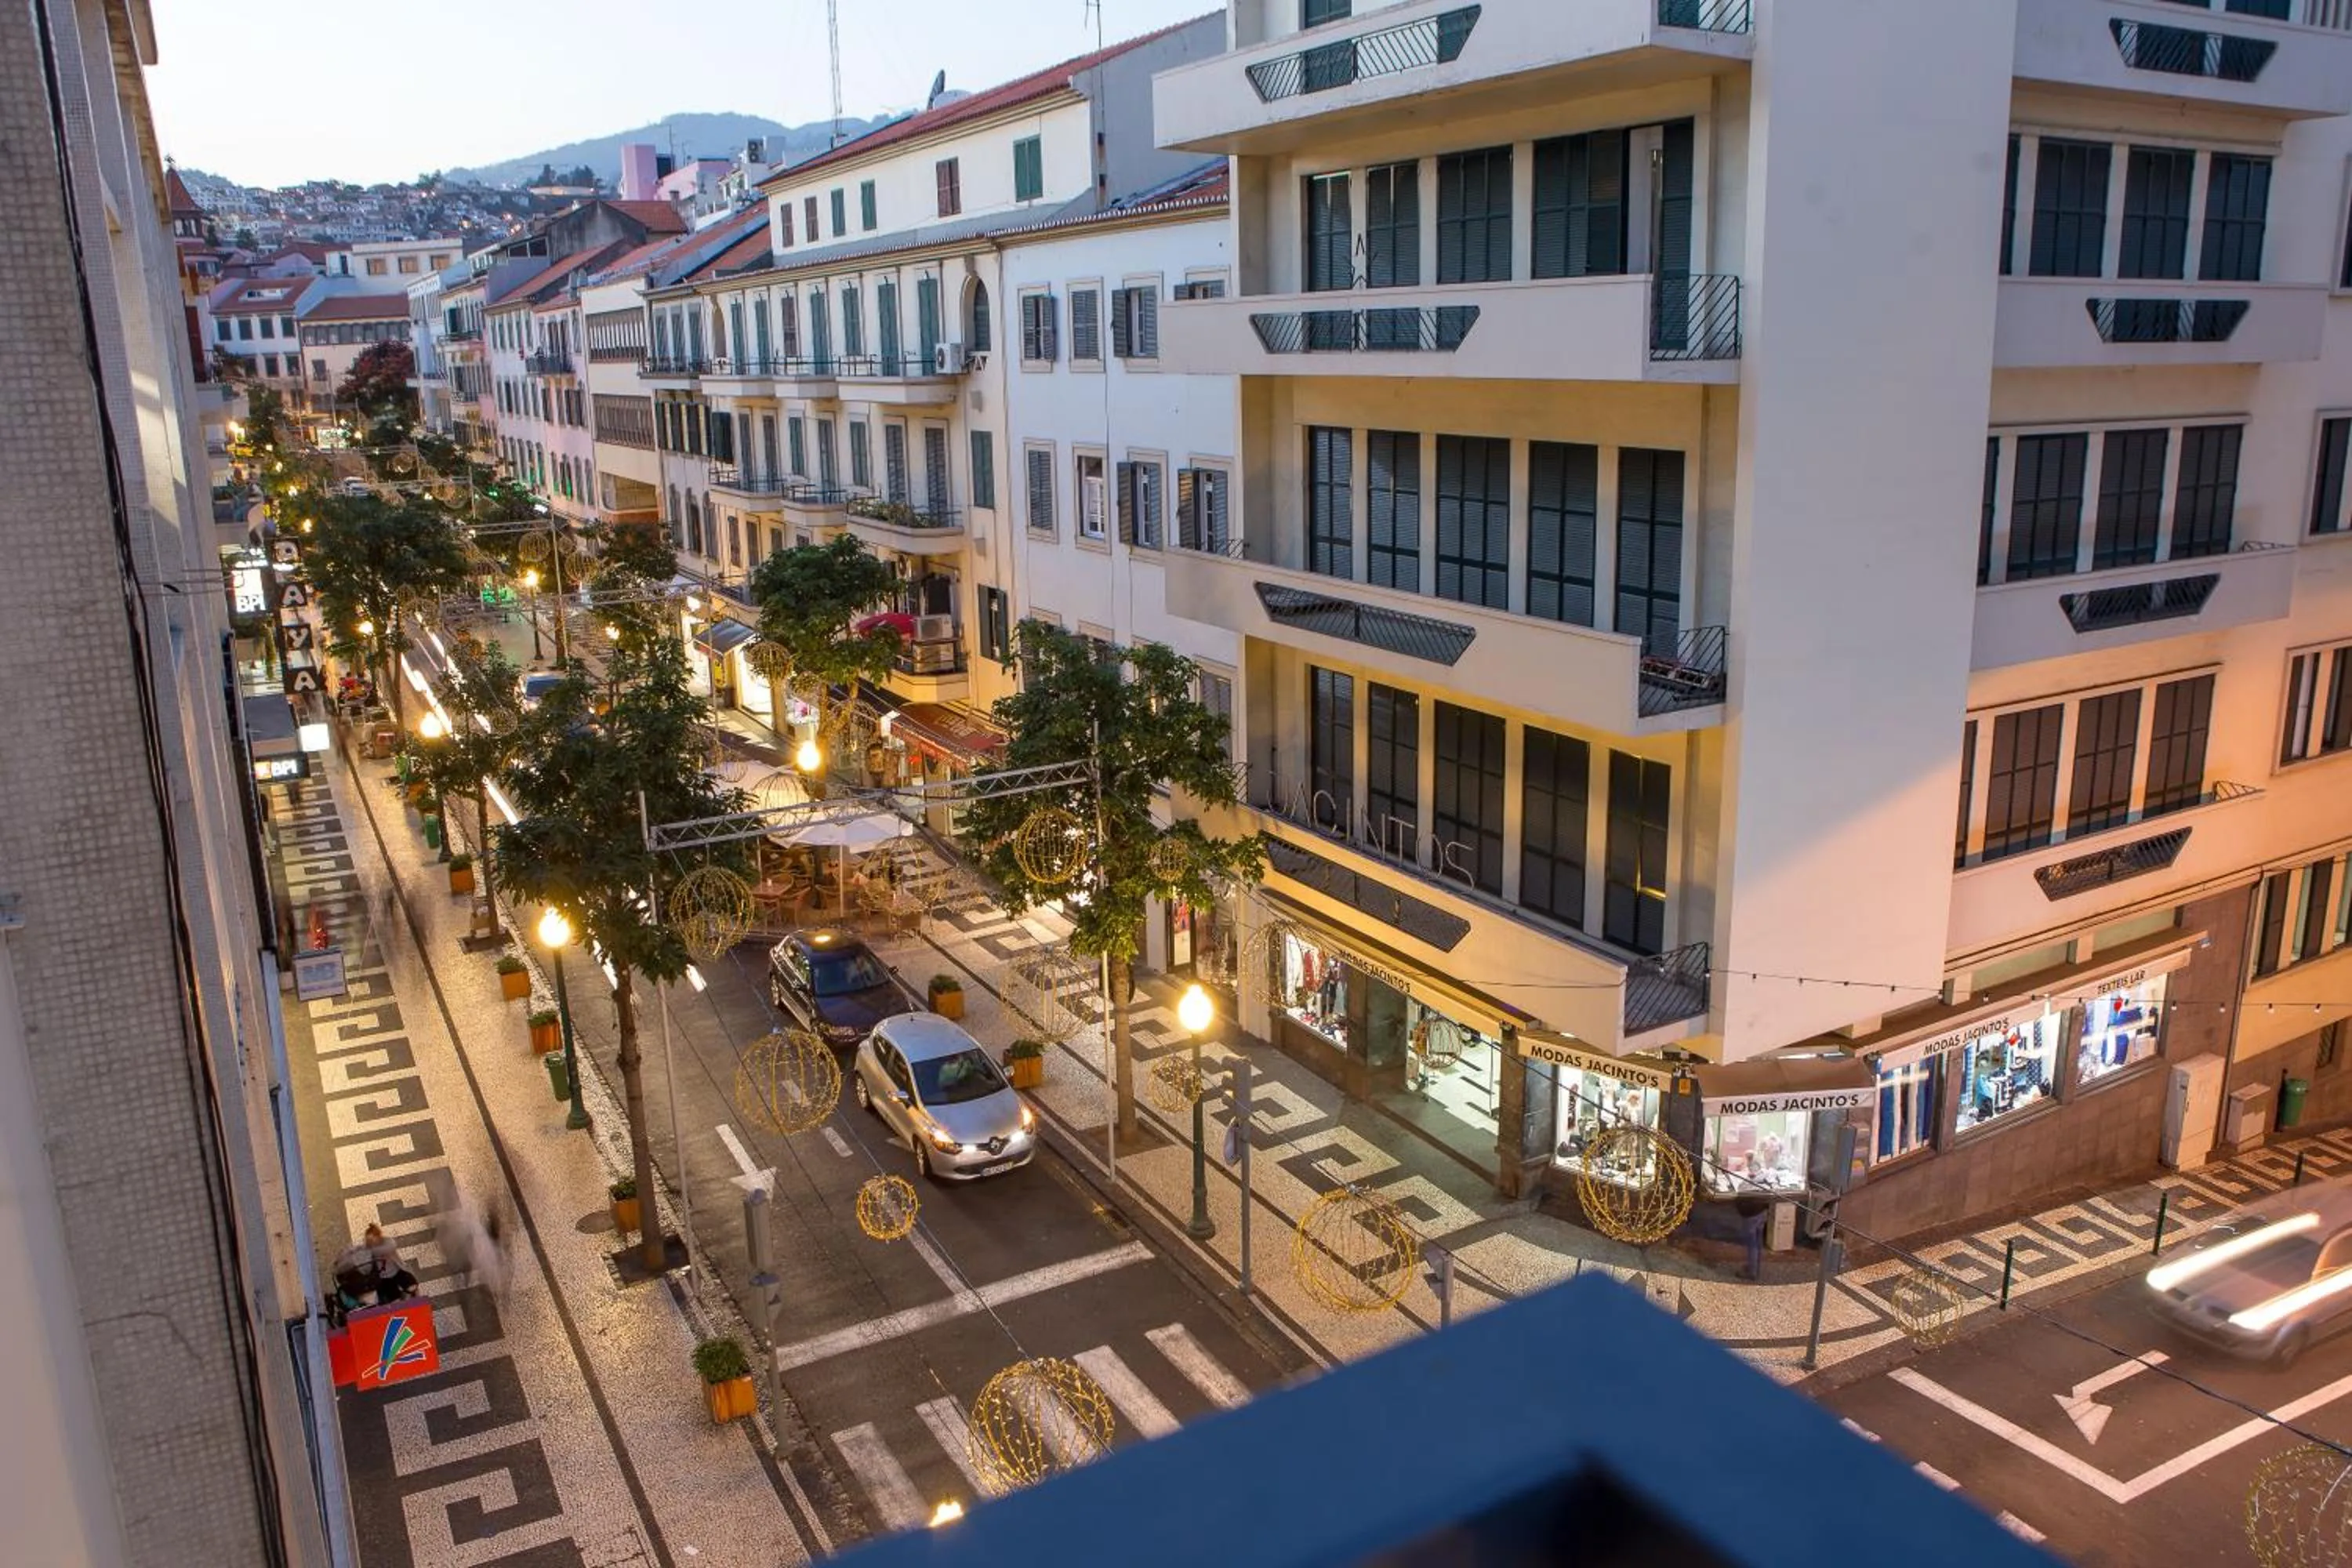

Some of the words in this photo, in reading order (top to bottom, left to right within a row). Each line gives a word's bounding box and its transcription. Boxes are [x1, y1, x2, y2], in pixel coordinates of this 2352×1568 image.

[236, 595, 266, 612] BPI
[271, 760, 298, 777] BPI
[1923, 1034, 1960, 1055] MODAS
[1530, 1045, 1581, 1067] MODAS
[1586, 1059, 1659, 1087] JACINTO'S
[1720, 1100, 1777, 1114] MODAS
[1781, 1094, 1859, 1111] JACINTO'S
